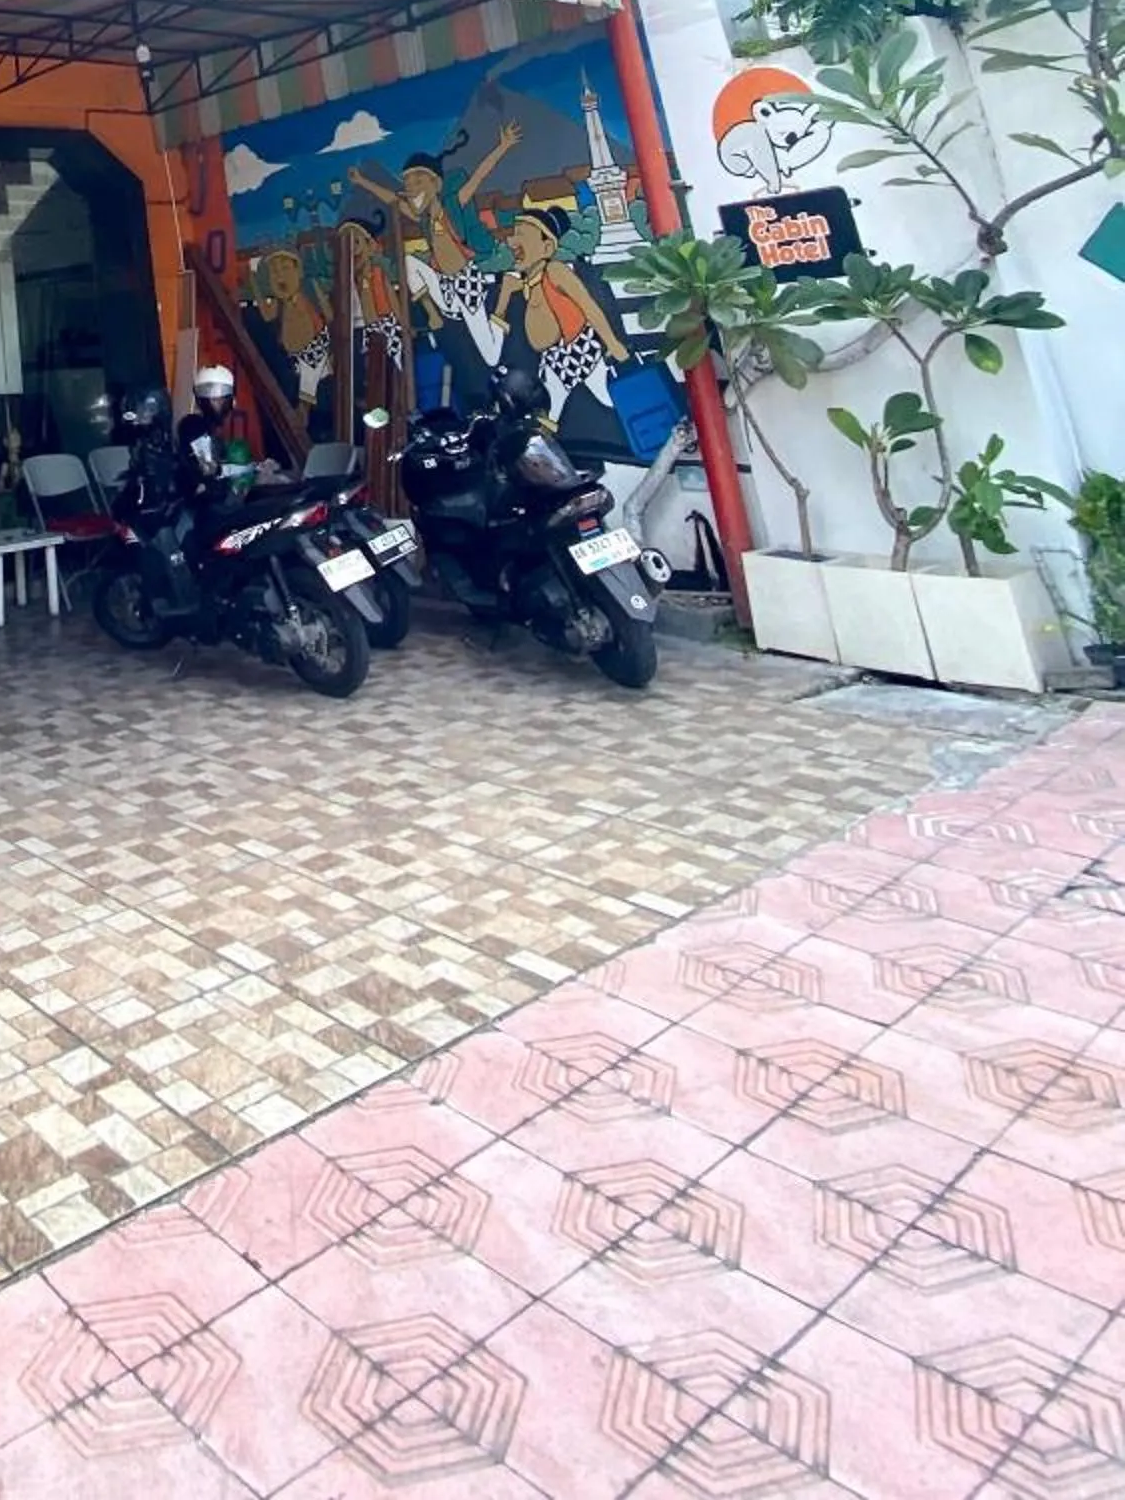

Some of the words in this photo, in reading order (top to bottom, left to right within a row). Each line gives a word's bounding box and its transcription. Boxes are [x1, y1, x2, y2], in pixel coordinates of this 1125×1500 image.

[746, 206, 776, 222] The
[750, 213, 831, 245] Cabin
[758, 237, 831, 268] Hotel
